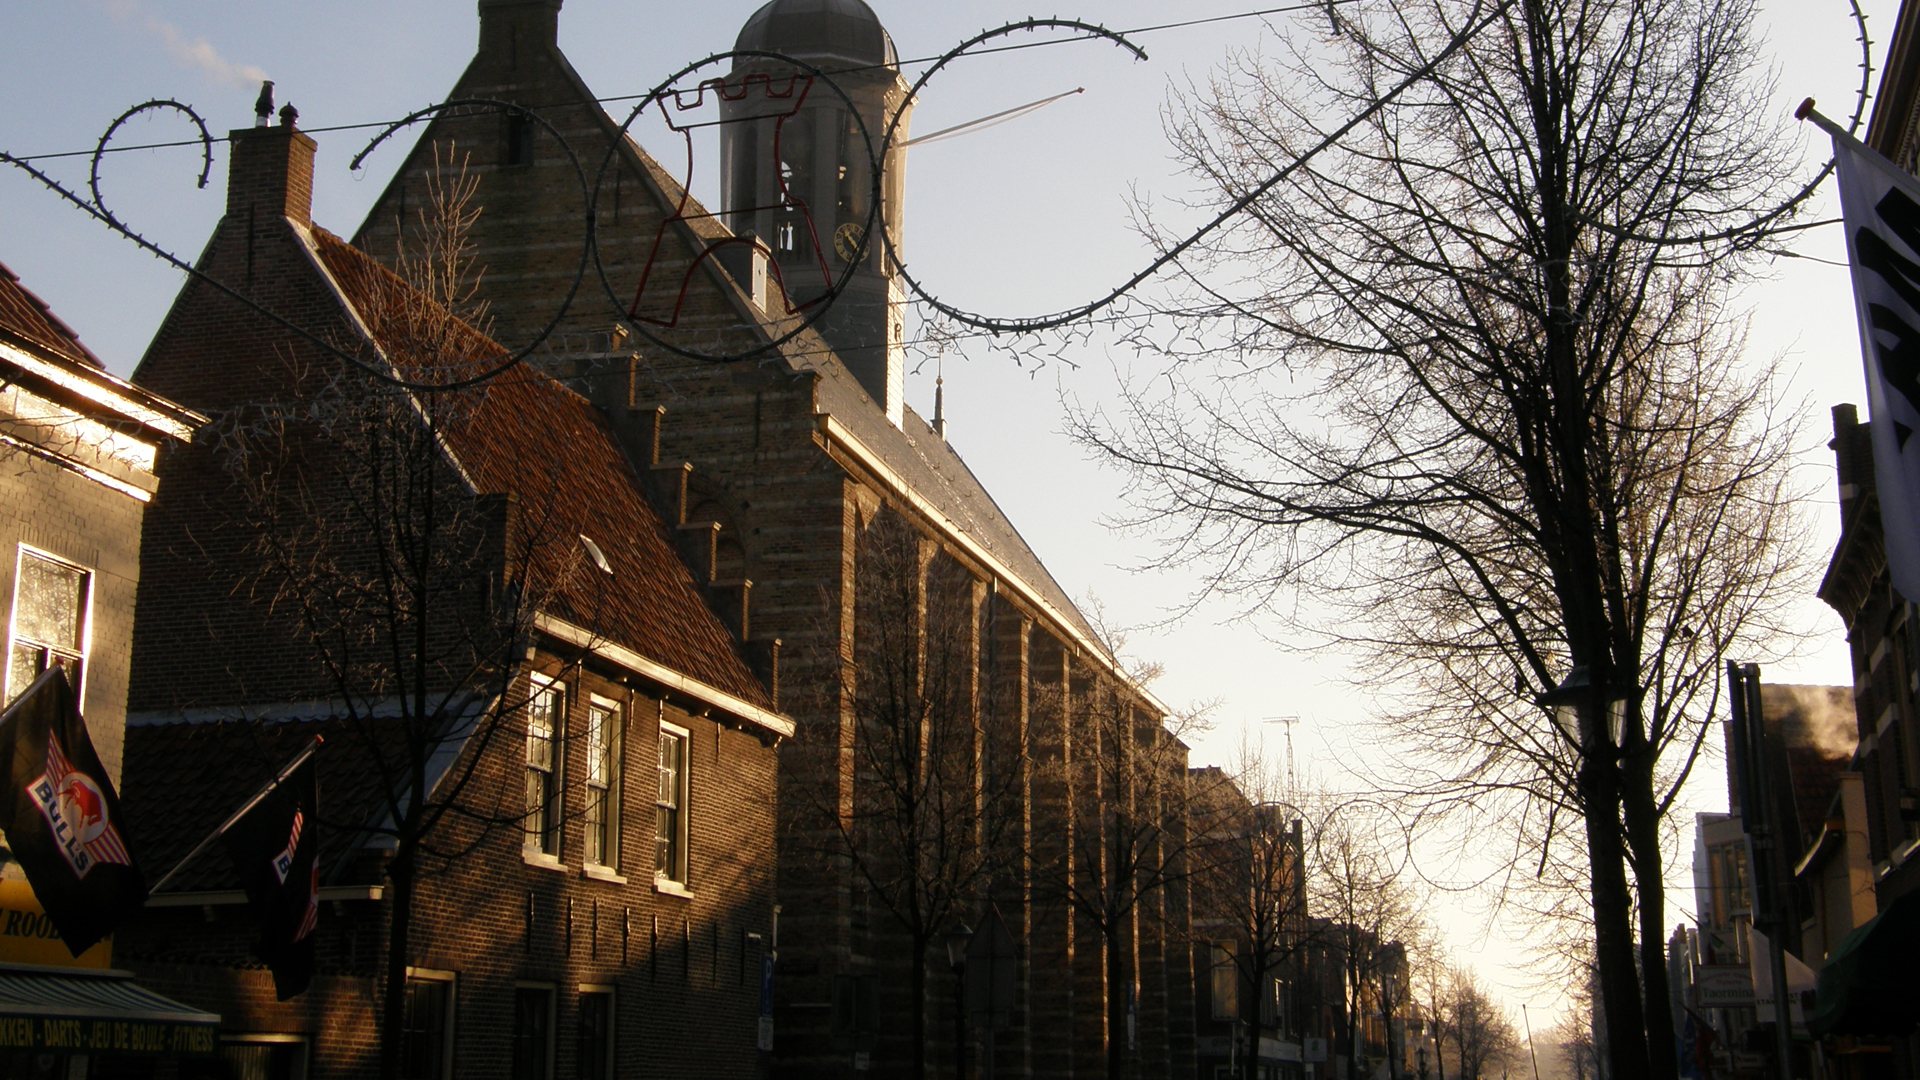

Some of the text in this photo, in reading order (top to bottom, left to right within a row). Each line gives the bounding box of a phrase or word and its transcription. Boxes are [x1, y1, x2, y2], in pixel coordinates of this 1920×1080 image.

[34, 781, 89, 871] BULLS
[1703, 988, 1755, 999] Taormina
[44, 1018, 82, 1049] DARTS
[89, 1021, 111, 1050] JEU
[113, 1021, 129, 1050] DE
[131, 1023, 167, 1052] BOULE
[172, 1025, 214, 1053] FITNESS
